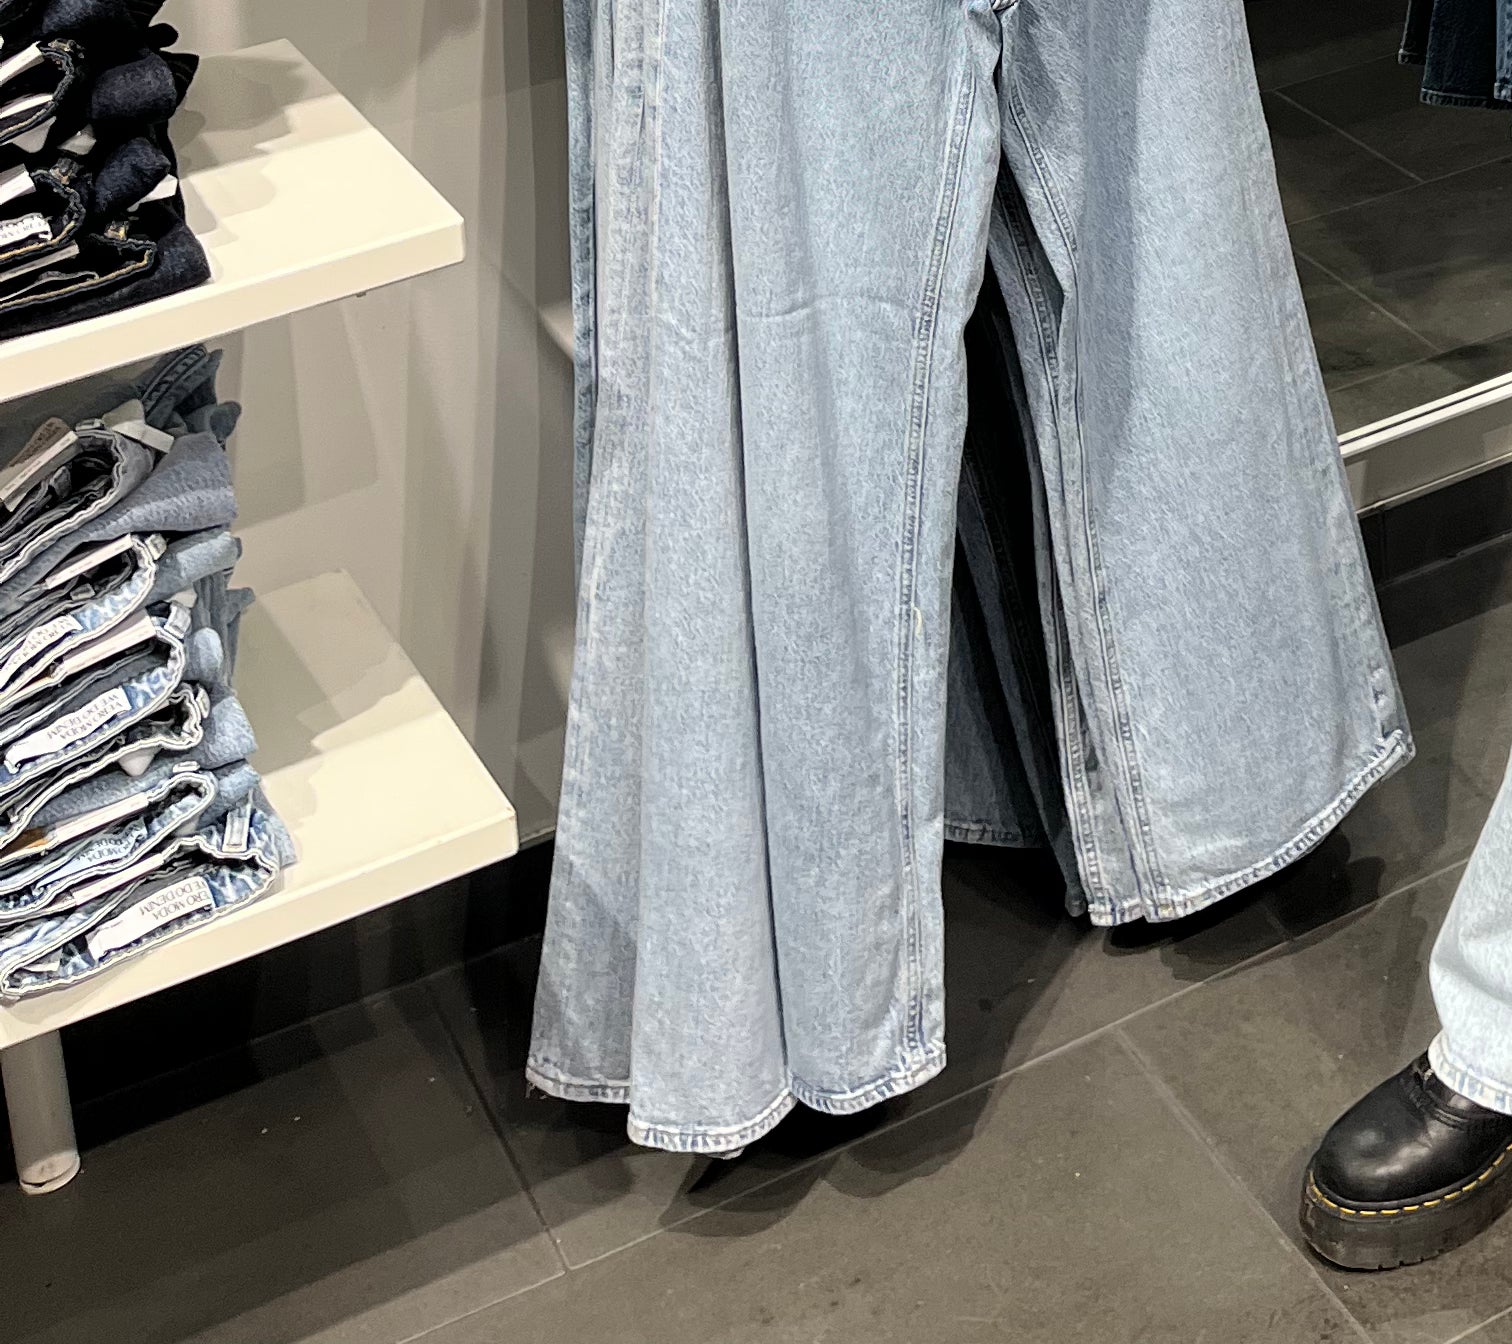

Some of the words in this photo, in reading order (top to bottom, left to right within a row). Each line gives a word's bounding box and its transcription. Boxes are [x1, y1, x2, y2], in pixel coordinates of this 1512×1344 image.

[176, 883, 192, 897] DO
[186, 891, 209, 906] ERO
[139, 891, 174, 916] DENIM
[152, 901, 185, 920] MODA
